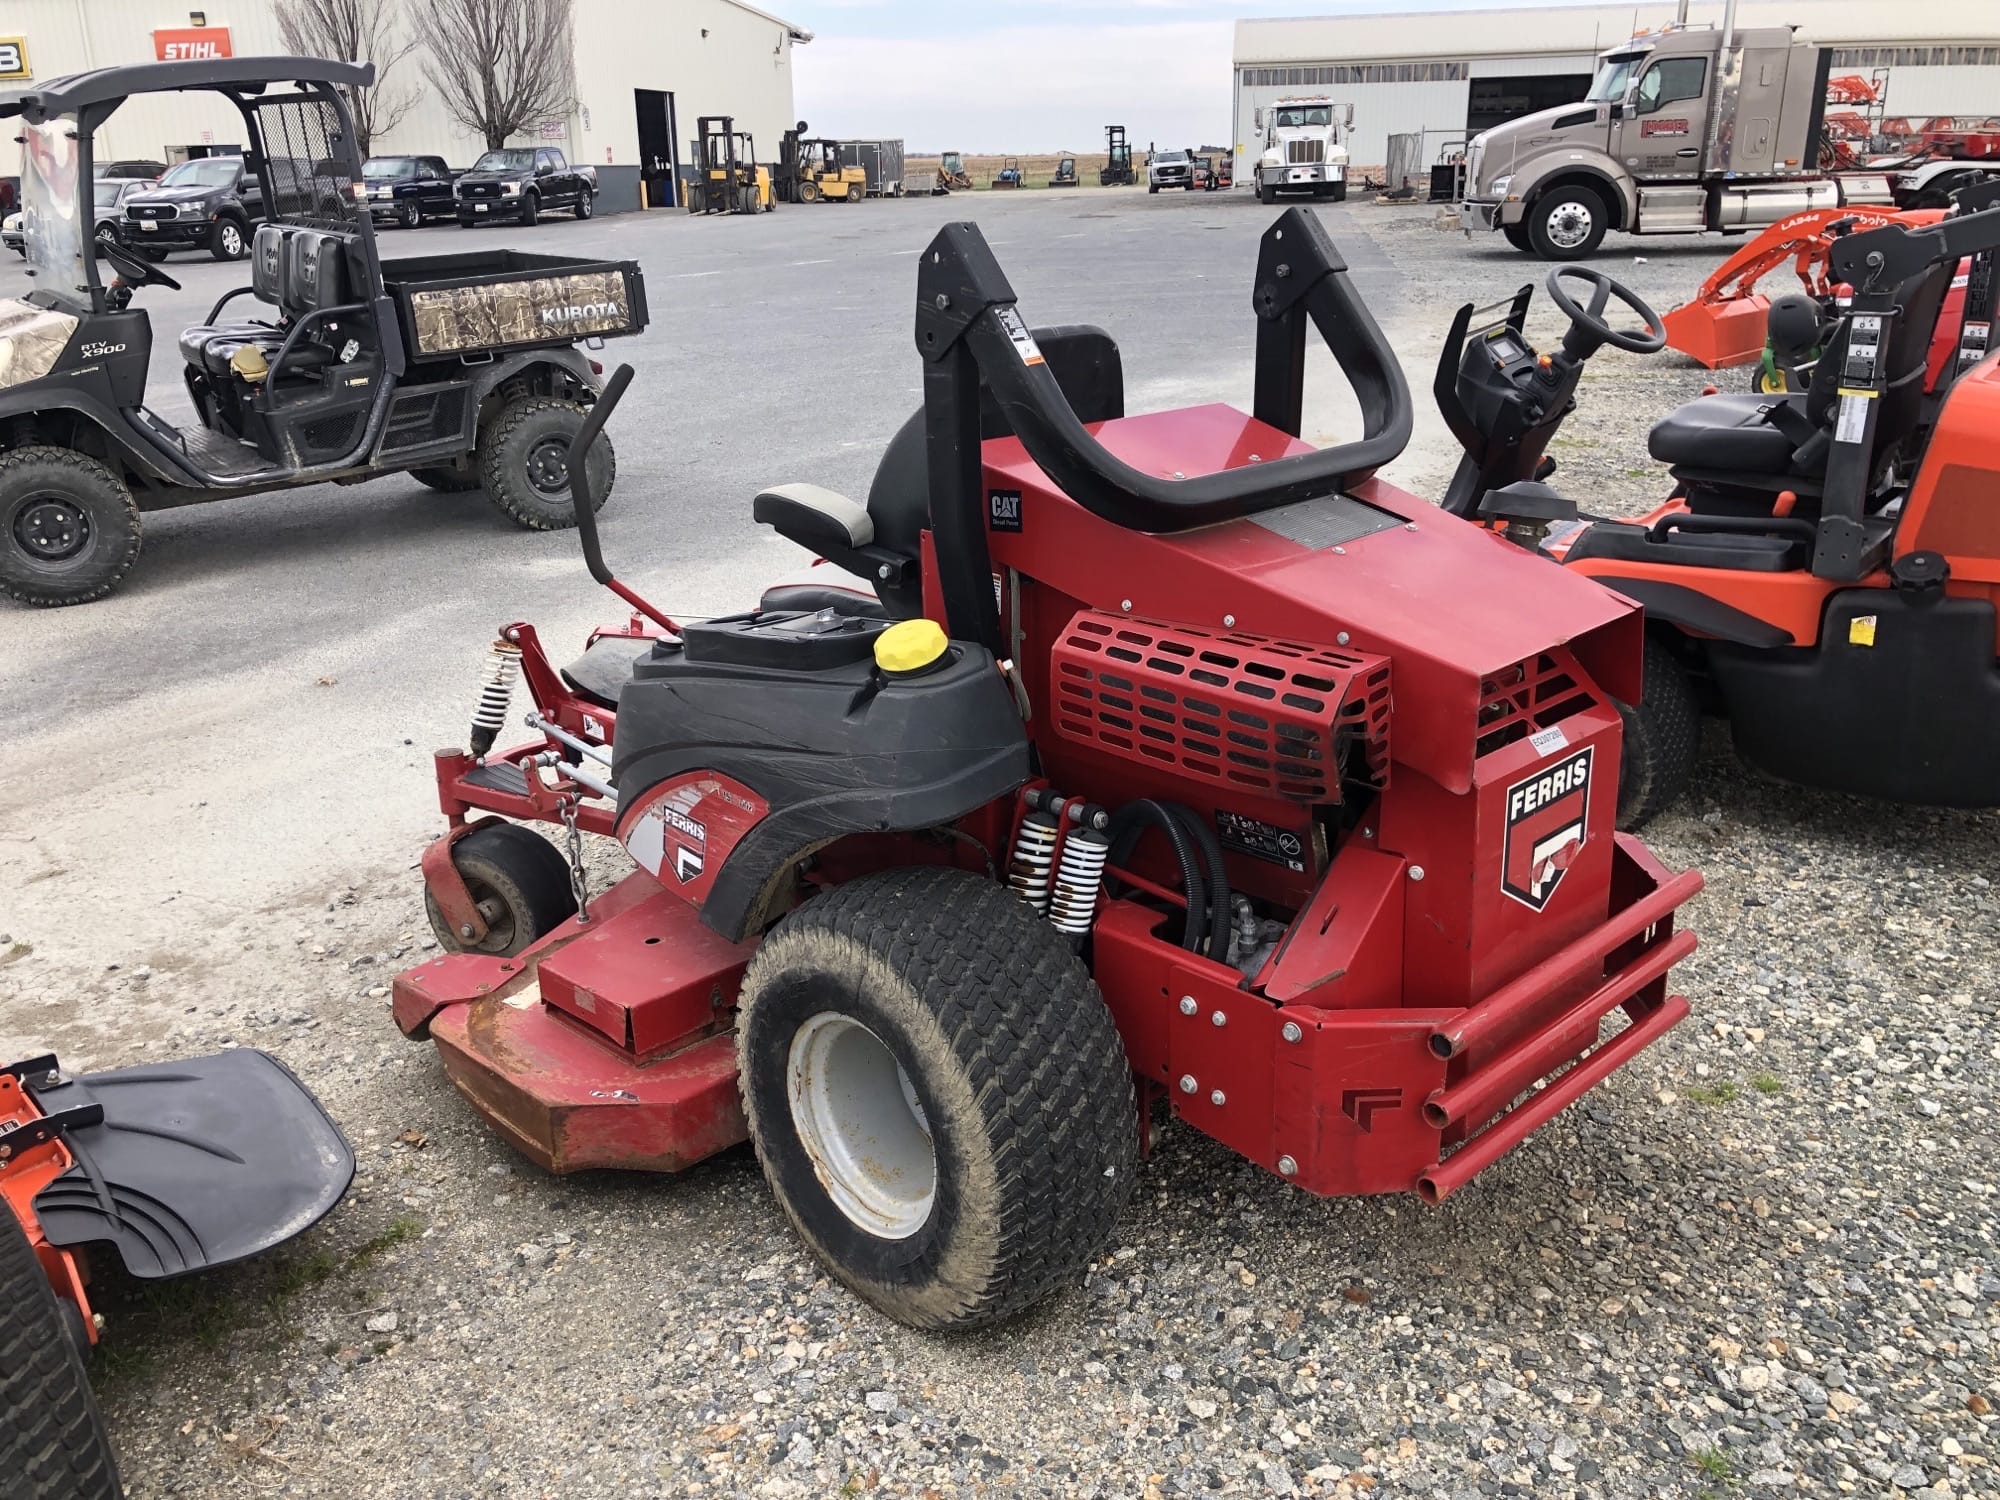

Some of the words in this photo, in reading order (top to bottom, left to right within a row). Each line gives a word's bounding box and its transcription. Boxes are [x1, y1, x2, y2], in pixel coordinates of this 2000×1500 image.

[164, 41, 222, 60] STIHL
[542, 302, 619, 324] KUBOTA
[81, 340, 107, 351] RTV
[82, 343, 126, 359] X900
[991, 495, 1019, 518] CAT
[1510, 758, 1587, 821] FERRIS
[664, 808, 705, 841] FERRIS
